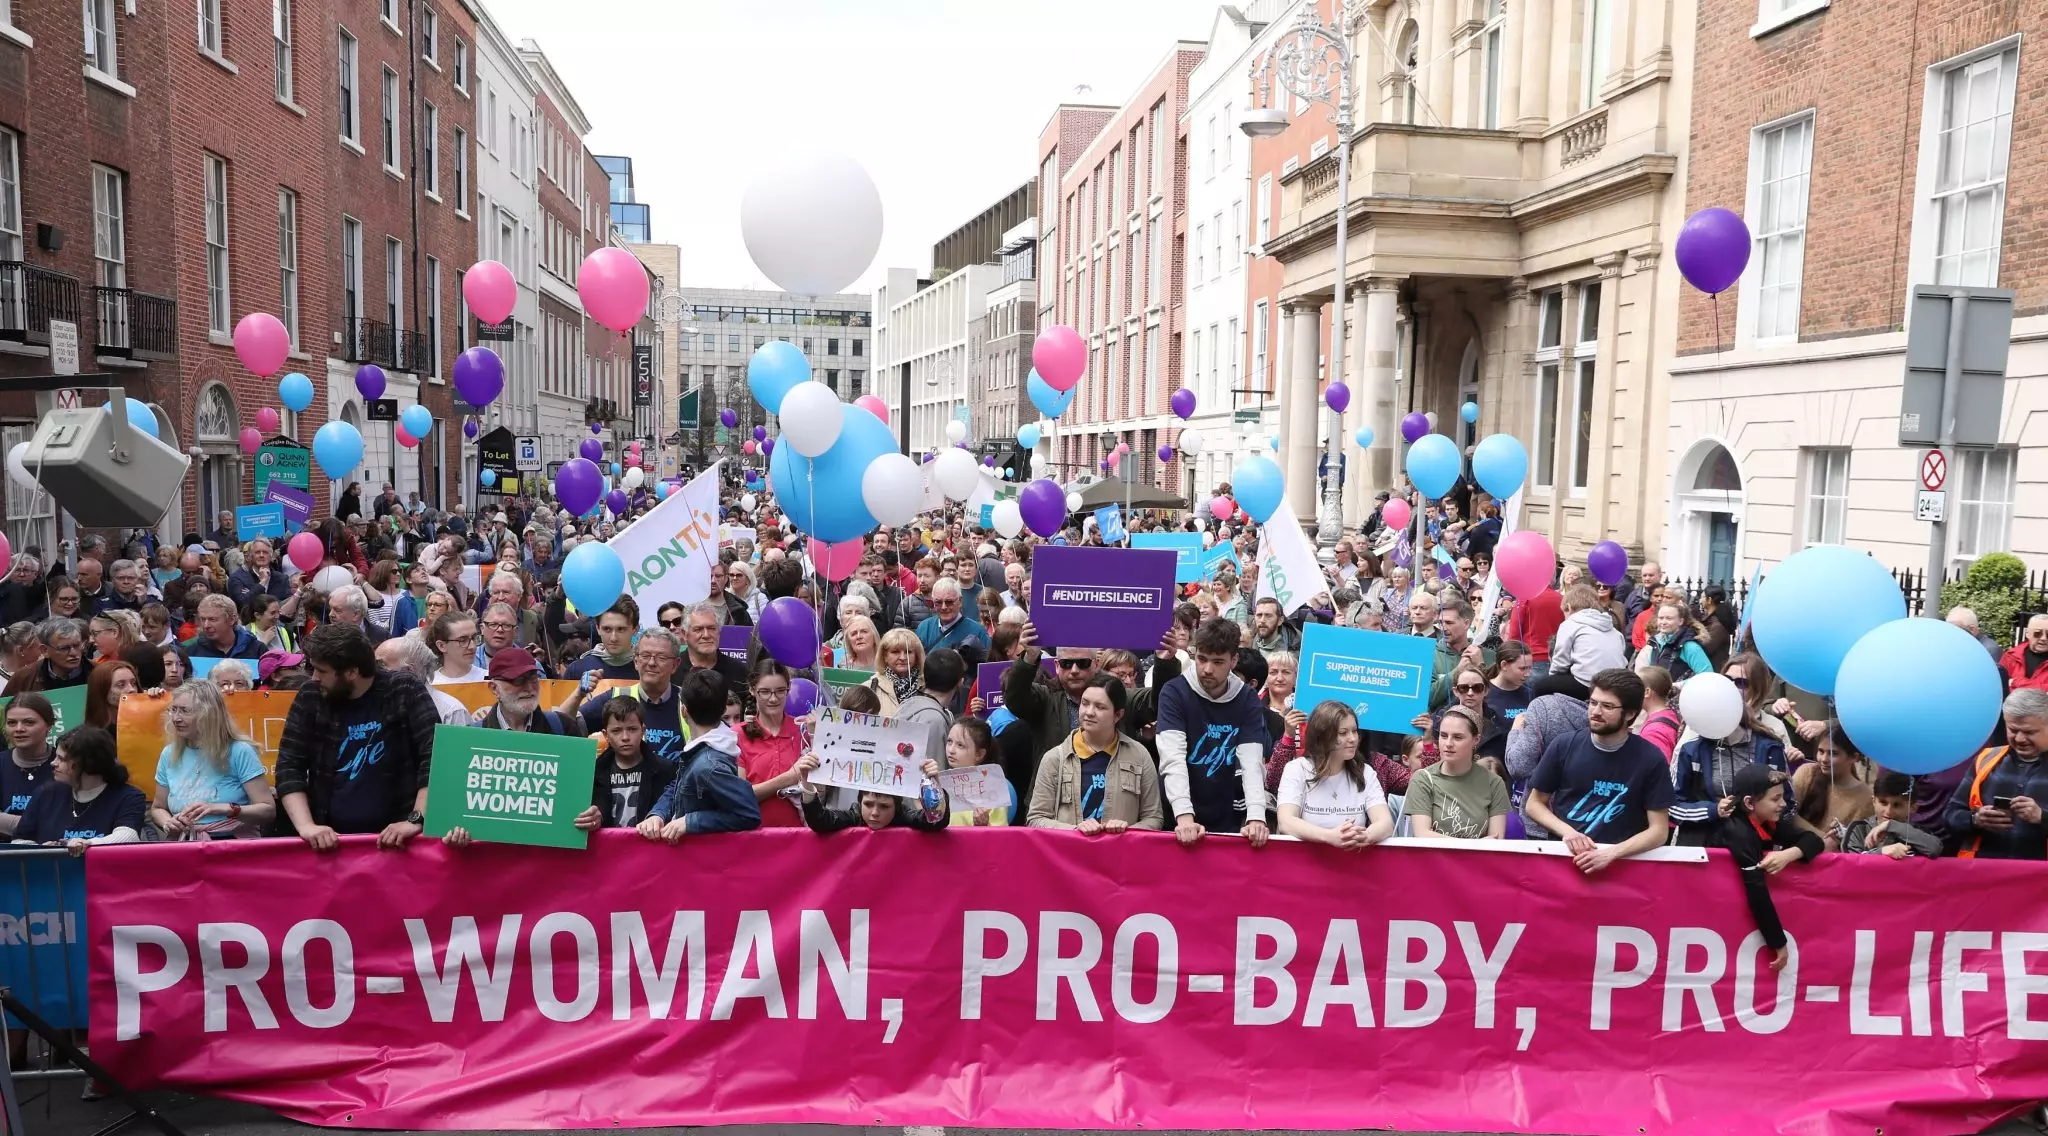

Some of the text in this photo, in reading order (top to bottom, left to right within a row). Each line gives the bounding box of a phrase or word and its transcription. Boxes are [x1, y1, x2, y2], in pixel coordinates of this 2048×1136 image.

[278, 452, 305, 461] QUINN
[482, 450, 509, 460] To Let
[524, 447, 533, 457] P
[276, 460, 307, 469] AGNEW
[1919, 499, 1931, 512] 24
[1052, 590, 1153, 604] #ENDTHESILENCE
[1326, 661, 1407, 679] SUPPORT MOTHERS
[1340, 674, 1390, 687] AND BABIES
[821, 706, 899, 729] ABORTION
[646, 728, 674, 738] MARCH
[1207, 723, 1233, 733] MARCH
[350, 731, 366, 741] FOR
[646, 735, 661, 744] FOR
[1207, 731, 1221, 740] FOR
[468, 755, 559, 777] ABORTION
[831, 756, 905, 786] MURDER
[466, 772, 557, 795] BETRAYS
[1593, 780, 1625, 791] MARCH
[1593, 787, 1611, 797] FOR
[12, 795, 33, 804] MAR
[466, 791, 555, 817] WOMEN
[0, 911, 77, 945] RCH
[112, 910, 2048, 1052] PRO-WOMAN, PRO-BABY, PRO-LIFE
